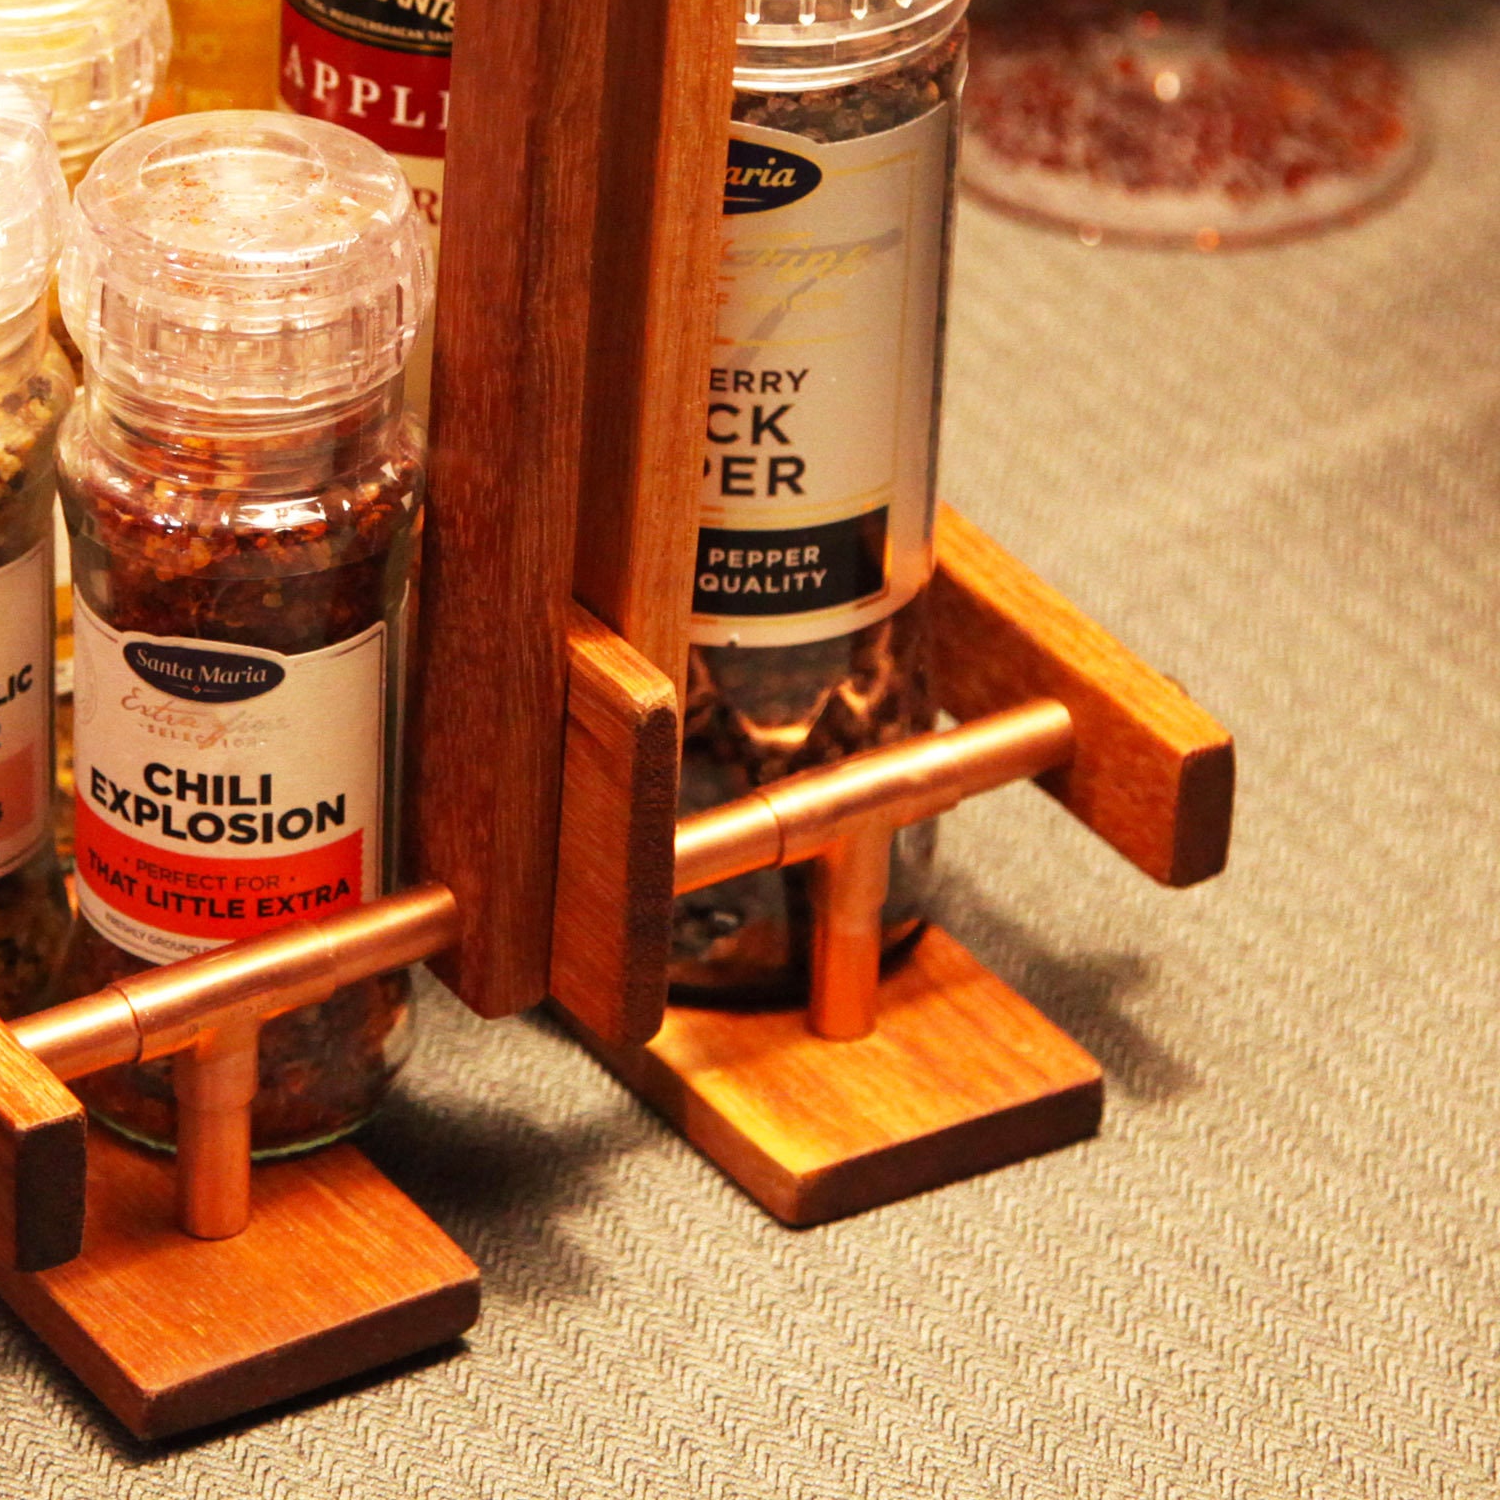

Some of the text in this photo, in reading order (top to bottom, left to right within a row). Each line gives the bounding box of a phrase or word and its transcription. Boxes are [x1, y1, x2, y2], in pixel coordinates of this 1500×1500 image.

[703, 455, 806, 497] ER
[708, 546, 820, 568] PEPPER
[699, 569, 827, 594] QUALITY
[136, 648, 267, 684] Santa Maria
[121, 686, 211, 726] Extra
[143, 762, 272, 806] CHILI
[90, 765, 346, 844] EXPLOSION
[88, 848, 351, 919] THAT LITTLE EXTRA
[136, 859, 280, 892] PERFECT FOR
